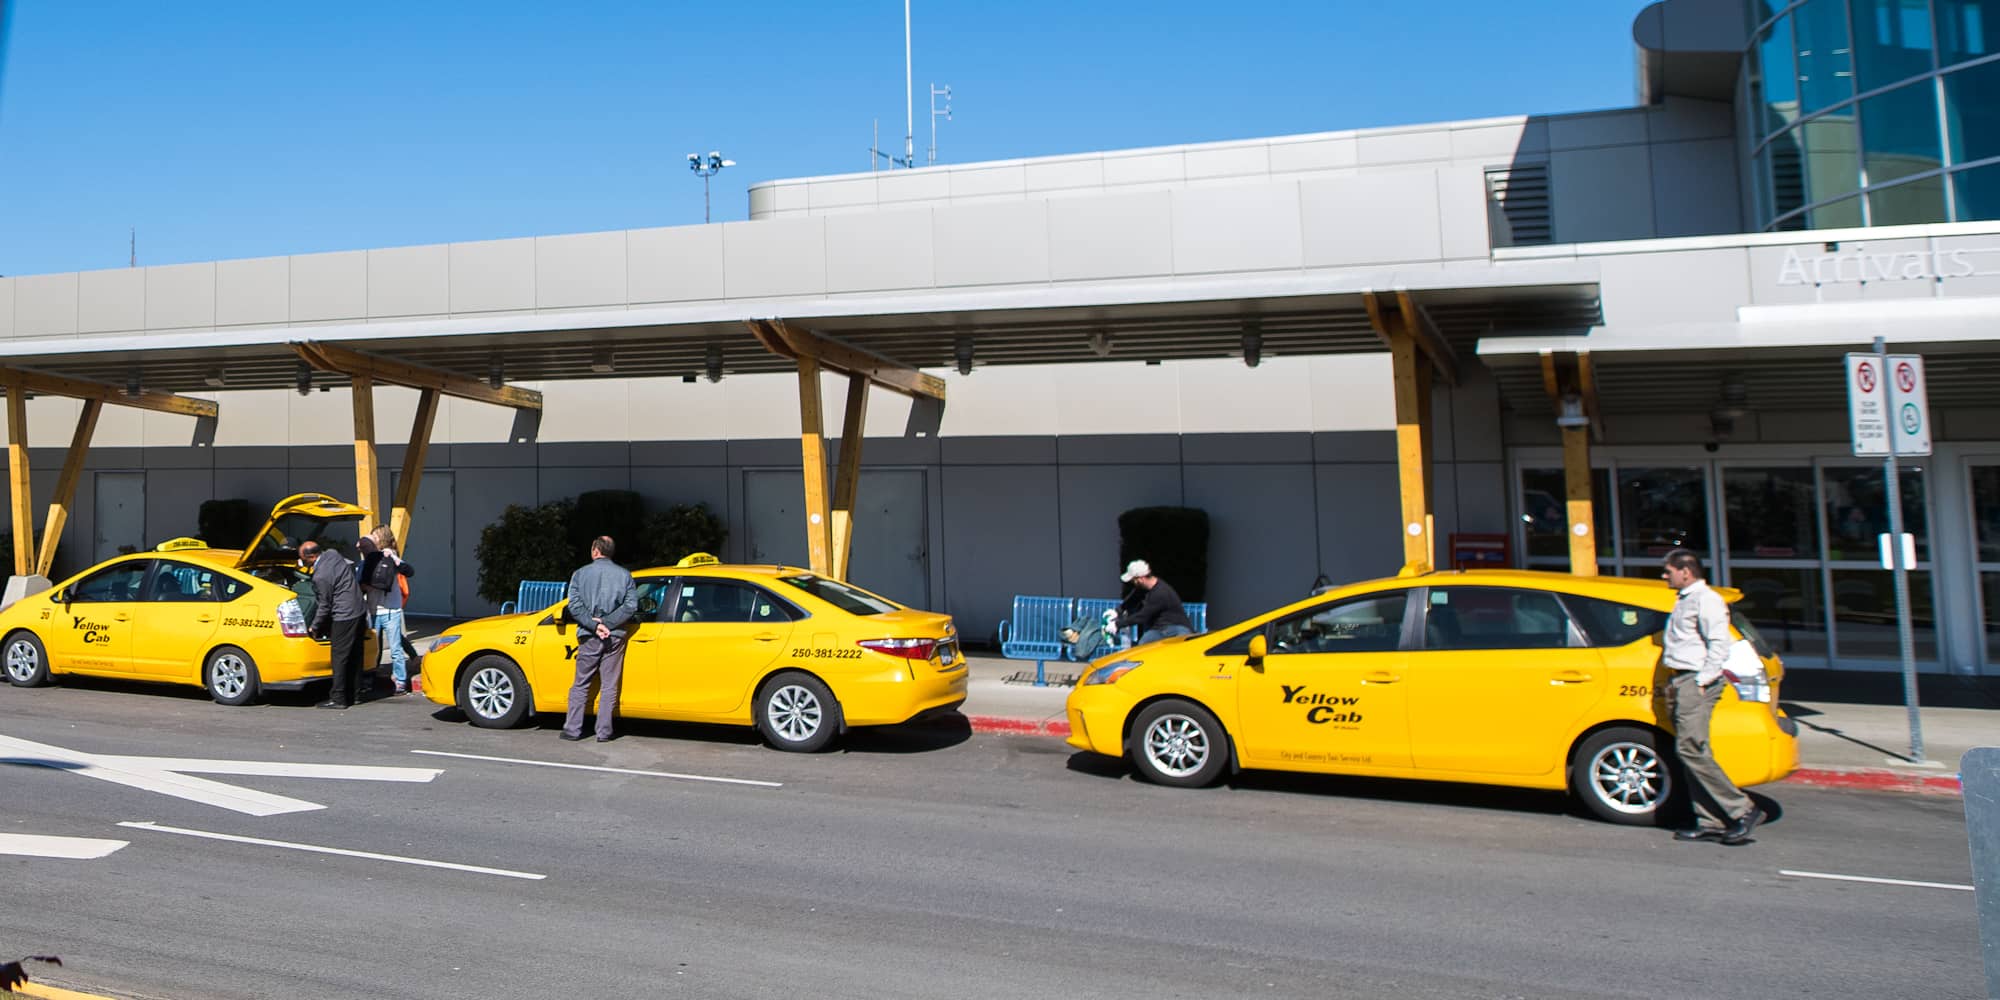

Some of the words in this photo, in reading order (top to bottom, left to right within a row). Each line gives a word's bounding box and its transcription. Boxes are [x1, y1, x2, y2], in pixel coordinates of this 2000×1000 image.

[1777, 240, 1975, 285] Arrivals
[73, 616, 110, 631] Yellow
[223, 618, 274, 628] 250-381-2222
[83, 631, 110, 643] Cab
[514, 635, 527, 645] 32
[792, 648, 862, 659] 250-381-2222
[1218, 663, 1225, 672] 7
[1281, 685, 1360, 705] Yellow
[1306, 706, 1363, 724] Cab
